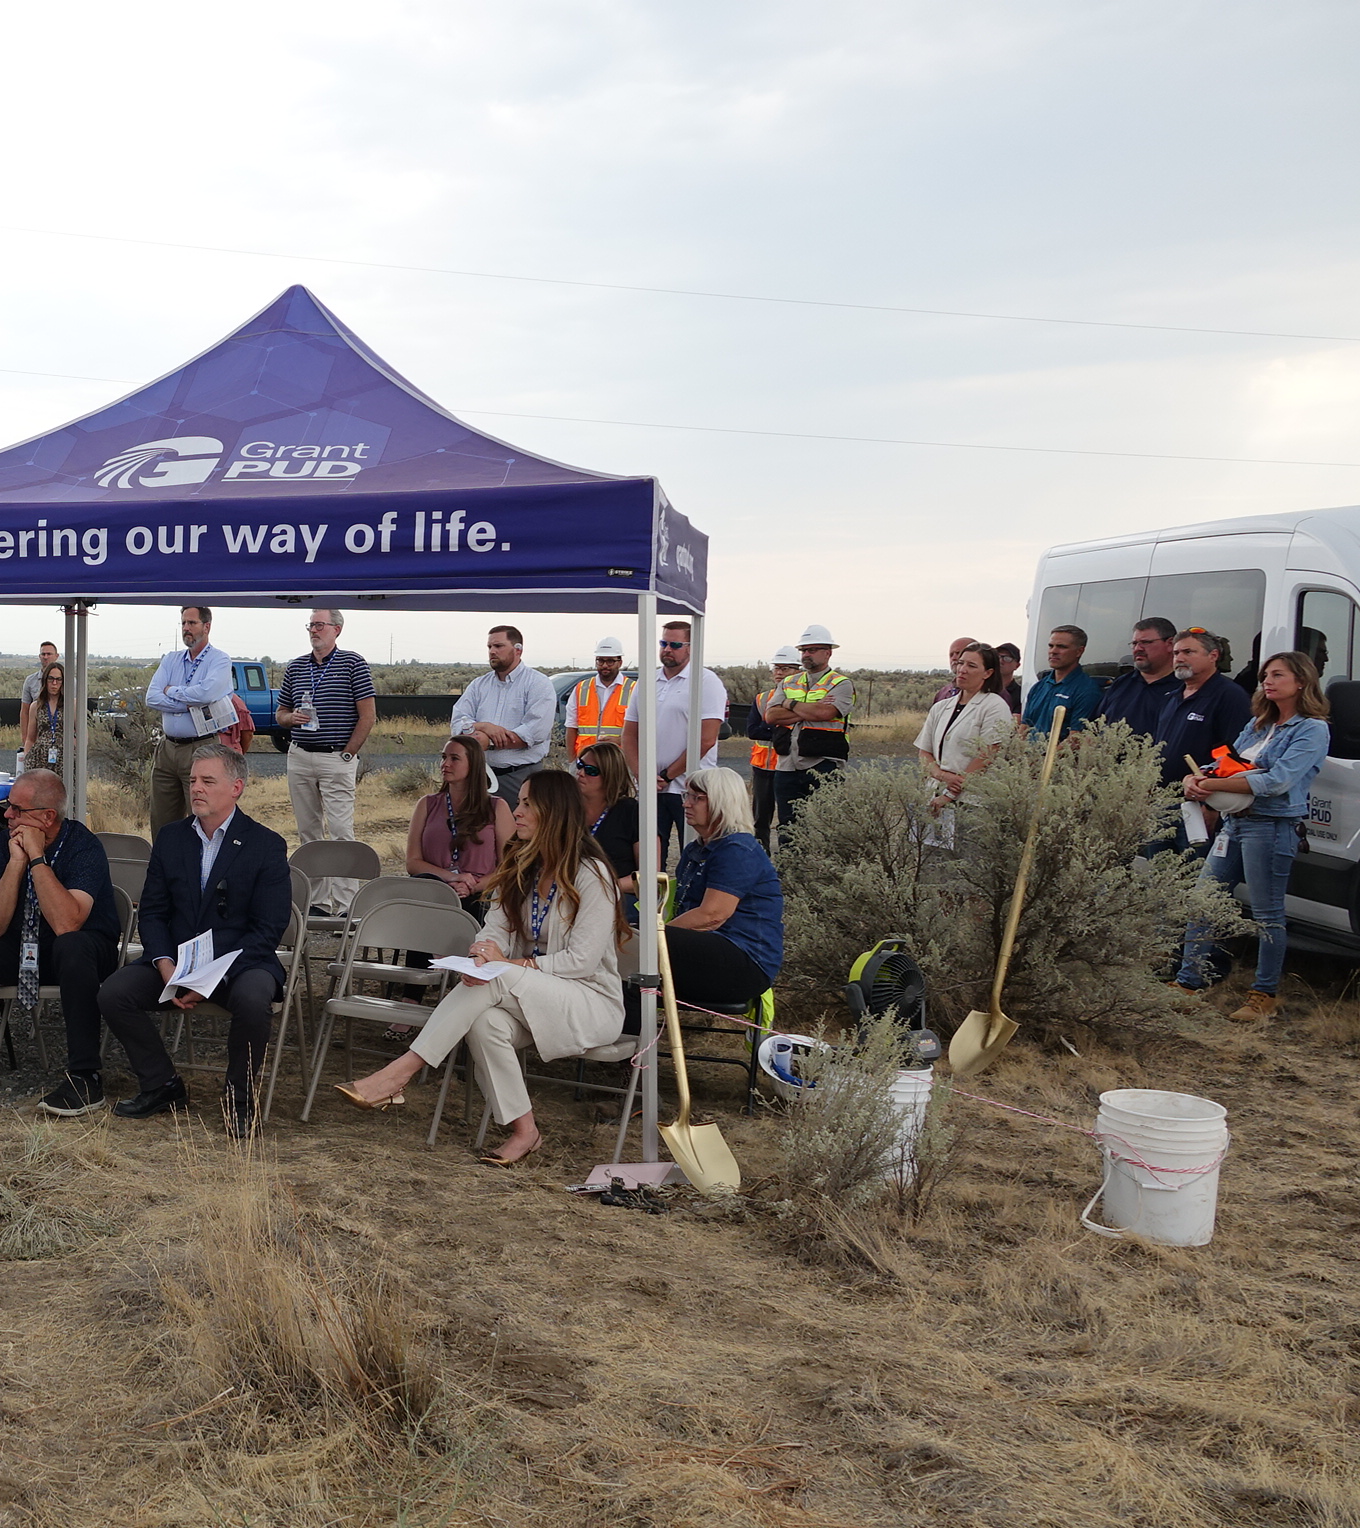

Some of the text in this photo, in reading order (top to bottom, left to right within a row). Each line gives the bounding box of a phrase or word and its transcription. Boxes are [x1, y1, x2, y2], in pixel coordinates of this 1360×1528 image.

[240, 441, 371, 459] Grant
[223, 460, 362, 478] PUD
[125, 524, 208, 556] our
[222, 523, 329, 563] way
[344, 511, 398, 554] of
[414, 510, 511, 553] life.
[1311, 796, 1332, 810] Grant
[1311, 808, 1332, 823] PUD
